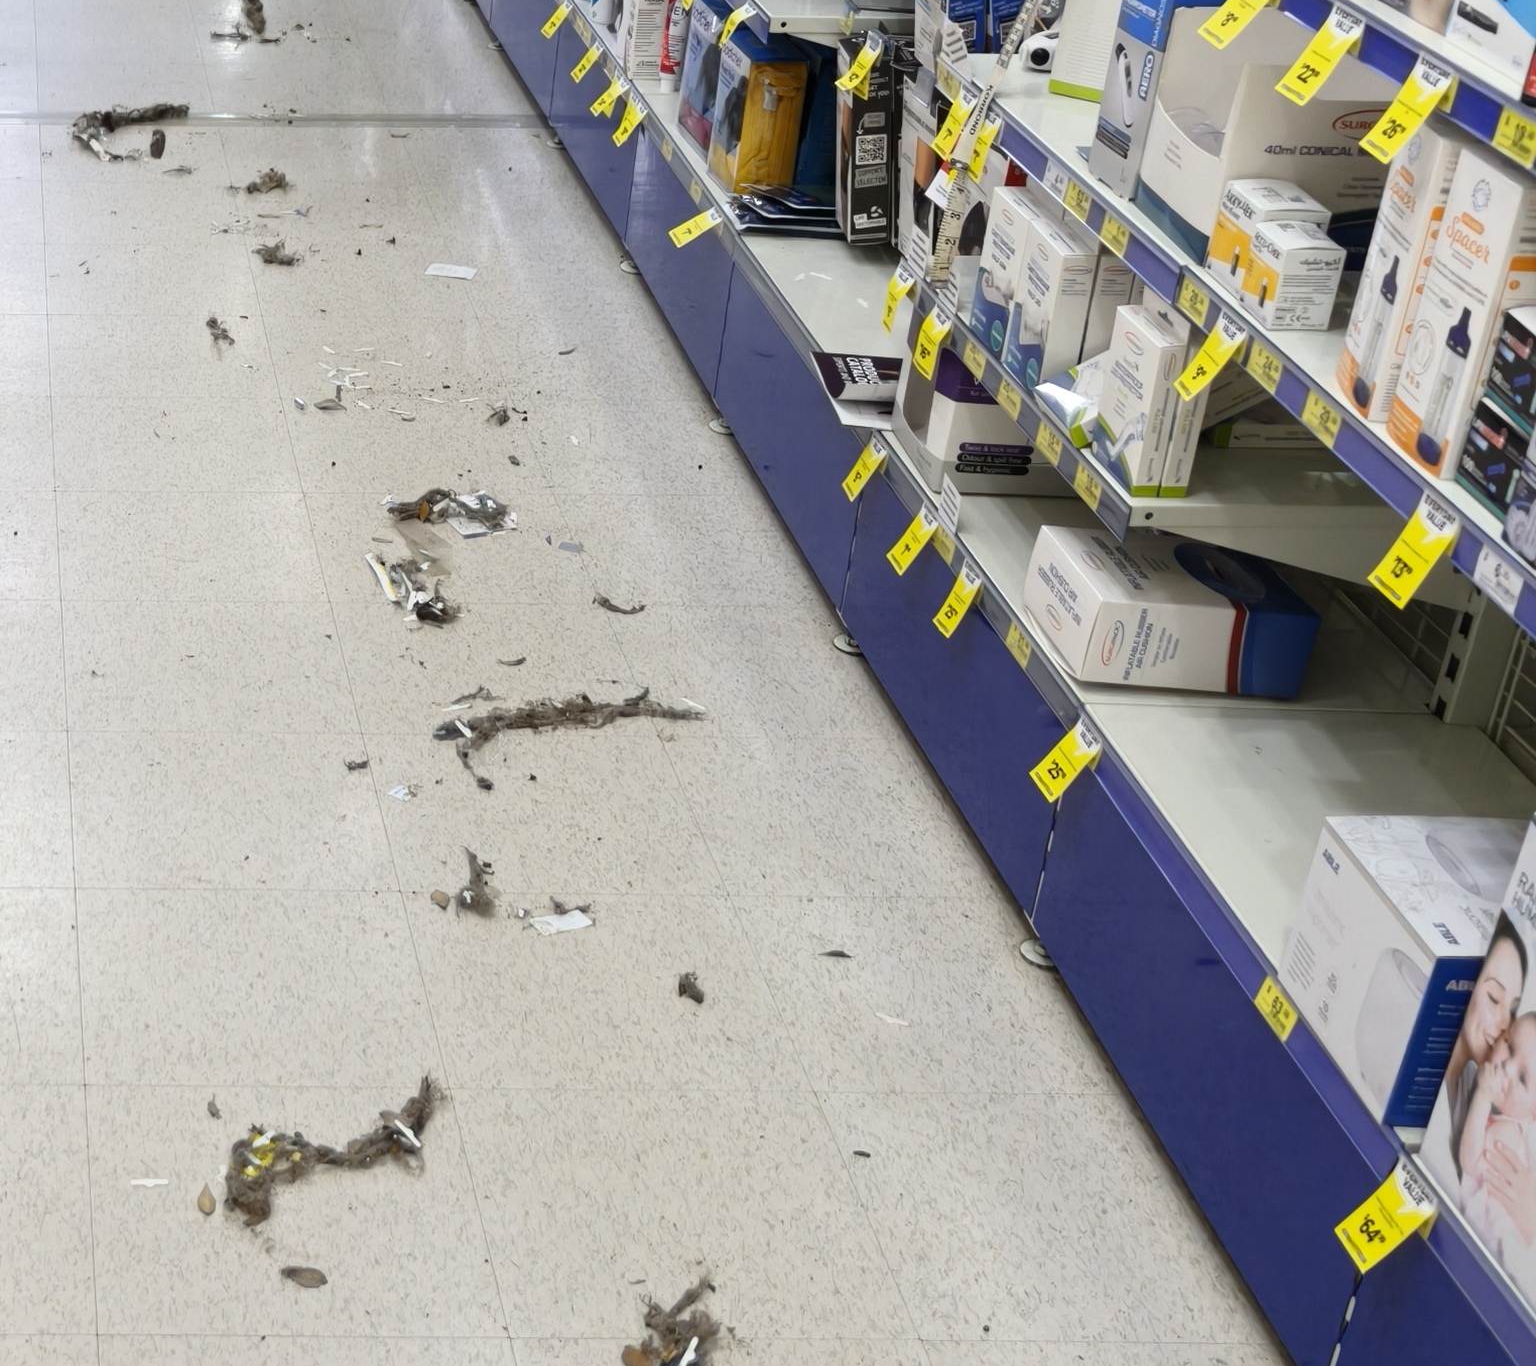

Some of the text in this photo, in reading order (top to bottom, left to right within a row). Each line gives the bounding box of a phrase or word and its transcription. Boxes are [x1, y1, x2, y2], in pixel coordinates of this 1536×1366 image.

[1140, 55, 1152, 98] AERO
[970, 85, 994, 136] KORBOND
[1265, 146, 1352, 157] 40ml CONICAL
[951, 212, 961, 221] 3
[946, 238, 956, 246] 2
[1445, 217, 1489, 263] Spacer
